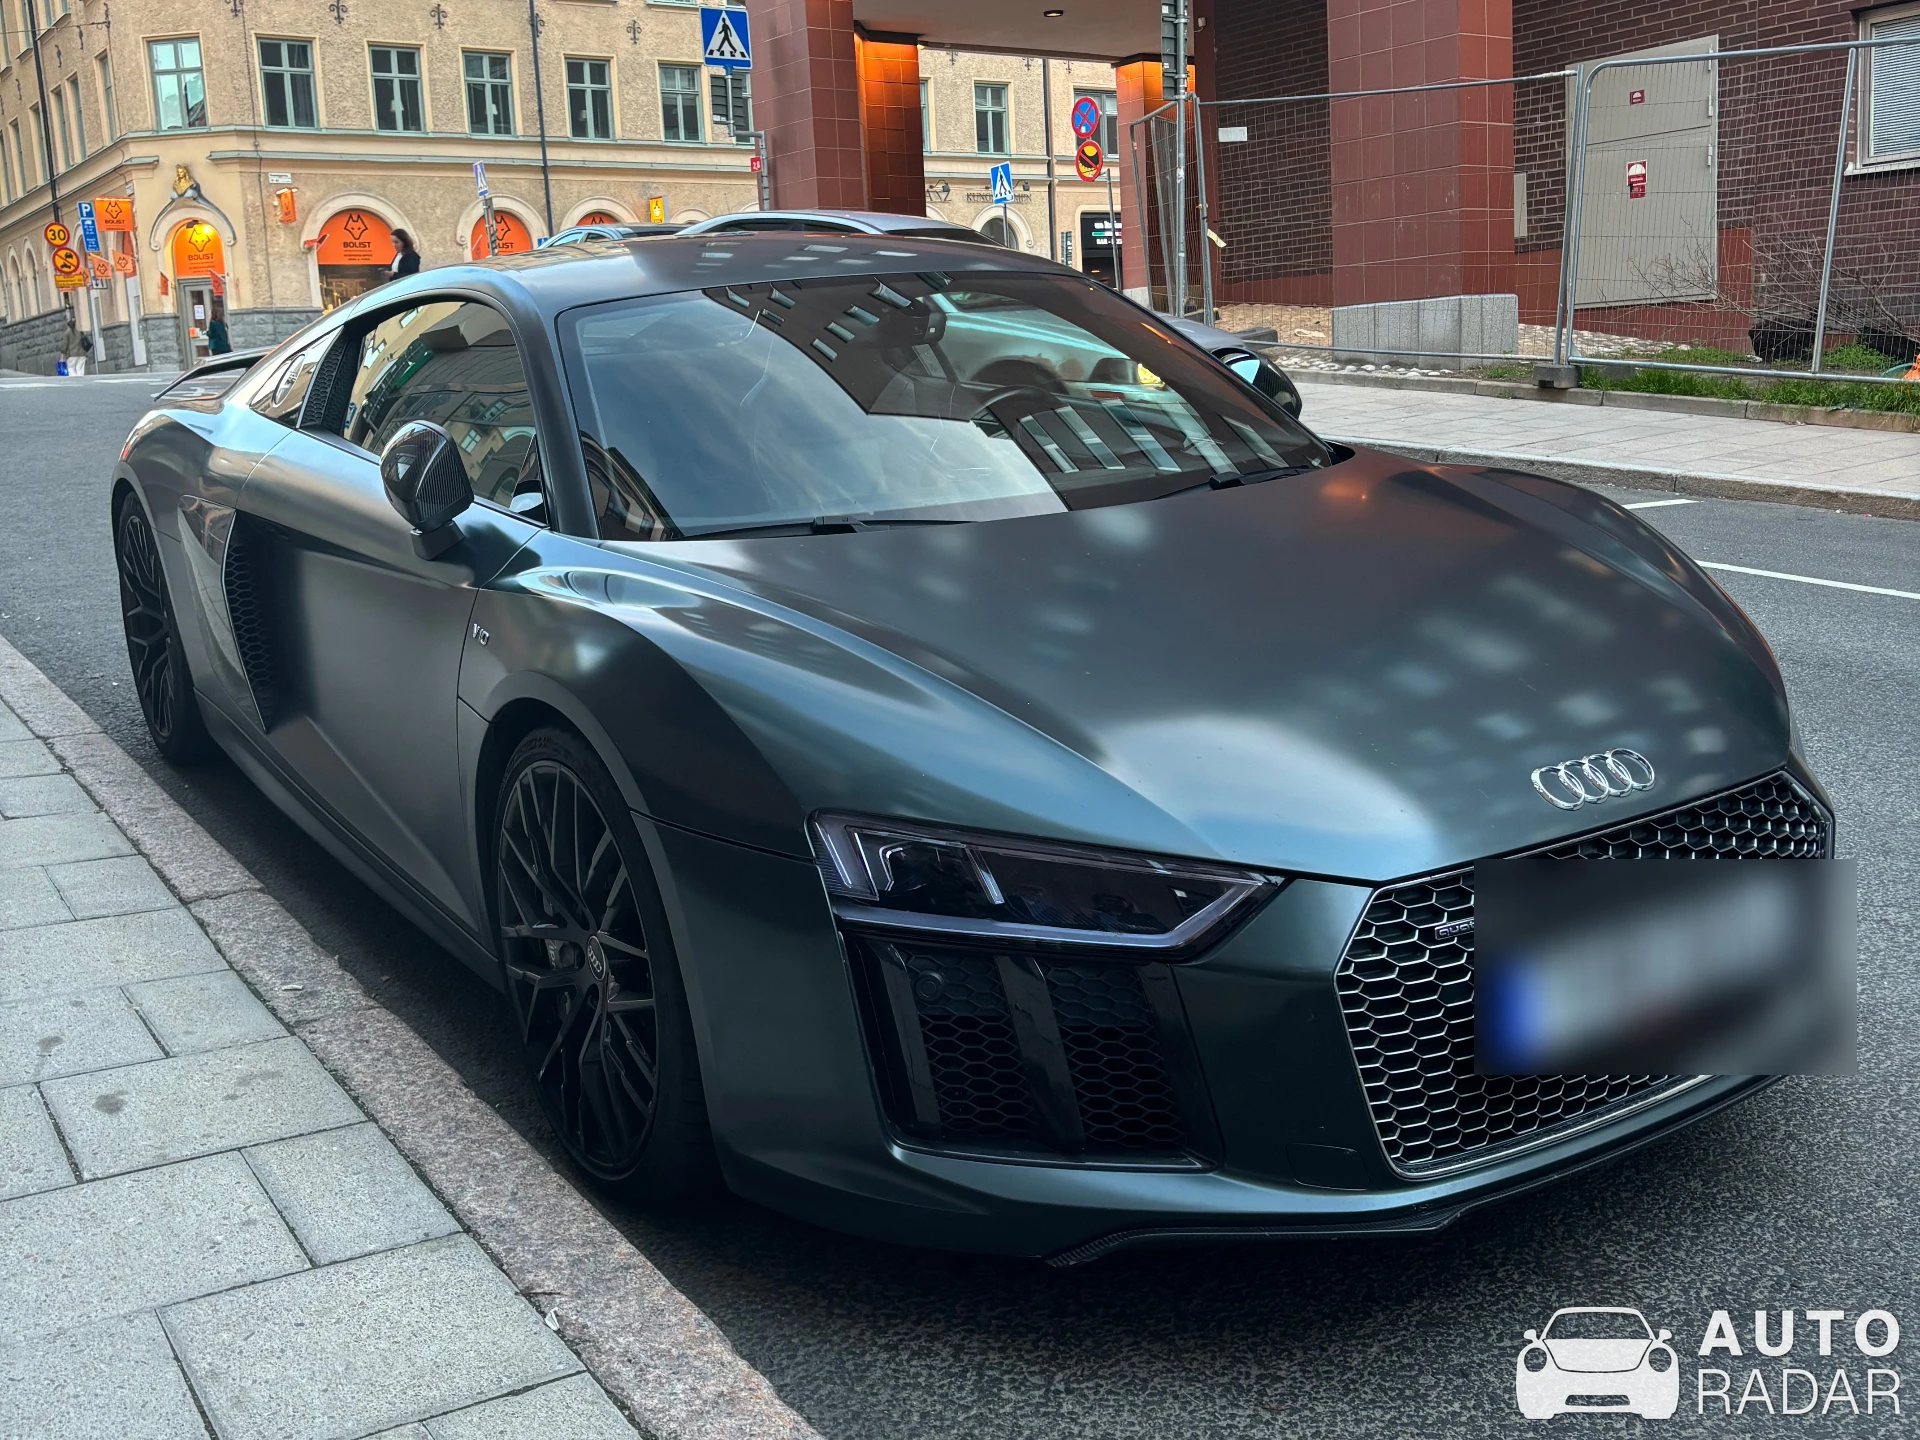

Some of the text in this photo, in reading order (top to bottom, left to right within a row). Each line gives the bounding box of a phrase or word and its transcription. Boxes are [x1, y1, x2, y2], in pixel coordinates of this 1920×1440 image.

[81, 203, 91, 217] P
[48, 229, 66, 241] 30
[187, 253, 215, 261] BOLIST
[472, 623, 490, 646] V10
